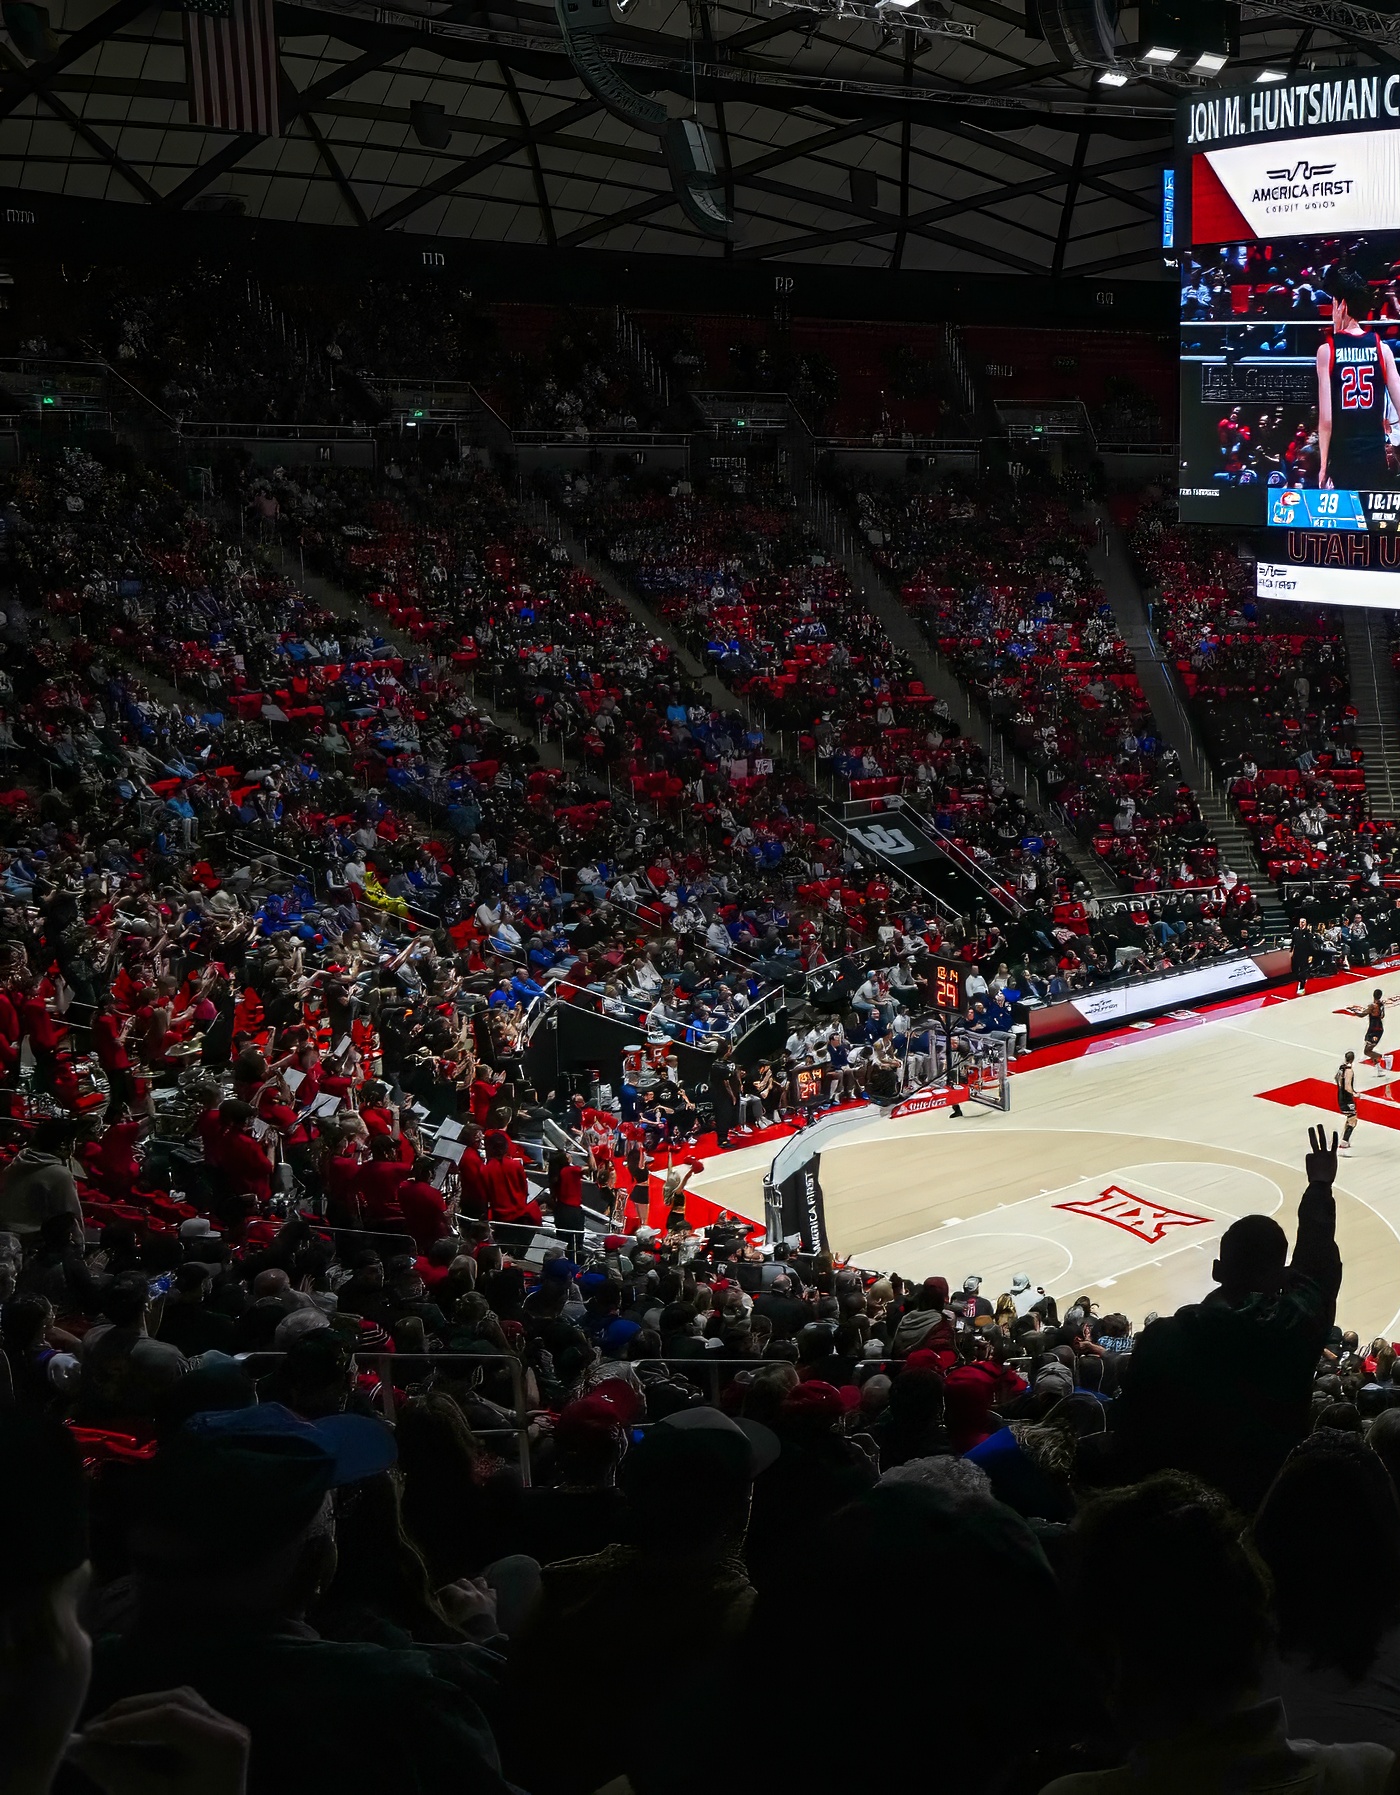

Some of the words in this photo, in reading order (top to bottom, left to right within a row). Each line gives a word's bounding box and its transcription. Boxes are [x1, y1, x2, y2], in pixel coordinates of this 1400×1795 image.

[1187, 100, 1221, 144] JON
[1223, 95, 1246, 137] M.
[1250, 76, 1381, 132] HUNTSMAN
[1252, 183, 1310, 203] AMERICA
[1311, 180, 1353, 199] FIRST
[1341, 365, 1374, 410] 25
[1287, 531, 1371, 567] UTAH
[936, 982, 957, 1008] 29
